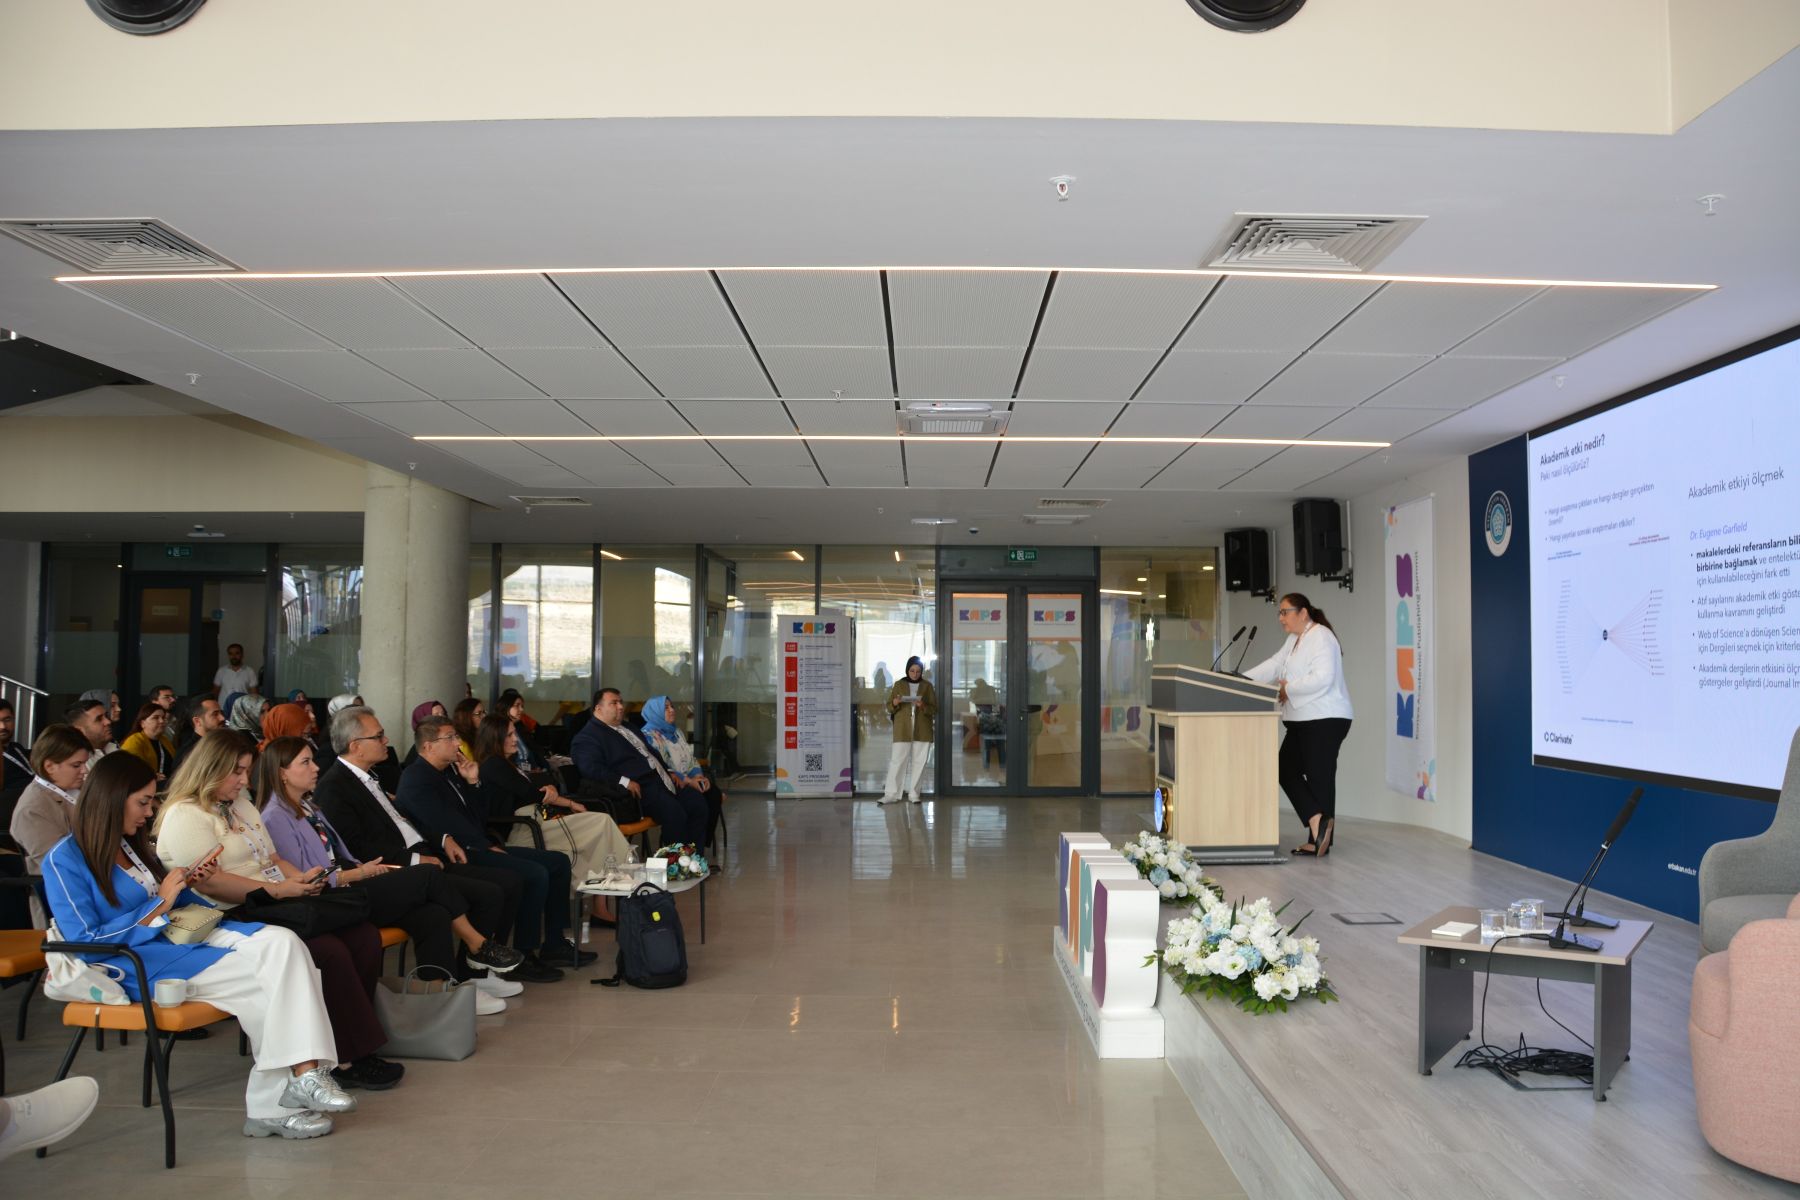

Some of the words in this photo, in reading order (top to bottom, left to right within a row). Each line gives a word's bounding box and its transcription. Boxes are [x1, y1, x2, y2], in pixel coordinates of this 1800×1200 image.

[1540, 446, 1570, 466] Akademik
[1571, 442, 1583, 458] etki
[1584, 434, 1606, 451] nedir?
[1688, 480, 1726, 500] Akademik
[1728, 474, 1750, 491] etkiyi
[1752, 466, 1784, 486] ölçmek
[1699, 528, 1721, 540] Eugene
[1722, 522, 1748, 535] Garfield
[1696, 543, 1741, 559] makalelerdeki
[1742, 538, 1787, 552] referansların
[1697, 560, 1722, 572] birbirine
[1724, 555, 1758, 570] bağlamak
[1758, 556, 1767, 564] ve
[1697, 576, 1706, 588] için
[1764, 568, 1777, 578] fark
[1778, 566, 1790, 576] etti
[1736, 590, 1766, 602] akademik
[1768, 589, 1780, 600] etki
[959, 609, 1001, 622] KAPS
[1034, 610, 1076, 622] KAPS
[1698, 609, 1723, 619] kullanma
[1725, 608, 1754, 617] kavramını
[1756, 604, 1785, 618] geliştirdi
[793, 622, 836, 634] KAPS
[1698, 630, 1711, 639] Web
[1713, 630, 1719, 638] of
[1720, 628, 1750, 638] Science'a
[1751, 627, 1780, 638] dönüşen
[1782, 626, 1800, 636] Scien
[1396, 553, 1414, 738] KAPS
[1698, 644, 1708, 654] için
[1709, 642, 1736, 655] Dergileri
[1736, 641, 1761, 654] seçmek
[1762, 641, 1774, 653] için
[1698, 663, 1727, 673] Akademik
[1728, 663, 1760, 676] dergilerin
[1761, 663, 1785, 673] etkisini
[1699, 677, 1733, 689] göstergeler
[1734, 677, 1761, 689] geliştirdi
[1763, 678, 1790, 689] (Journal
[1550, 732, 1572, 745] Clarivate
[1668, 862, 1697, 876] erbakan.edu.tr
